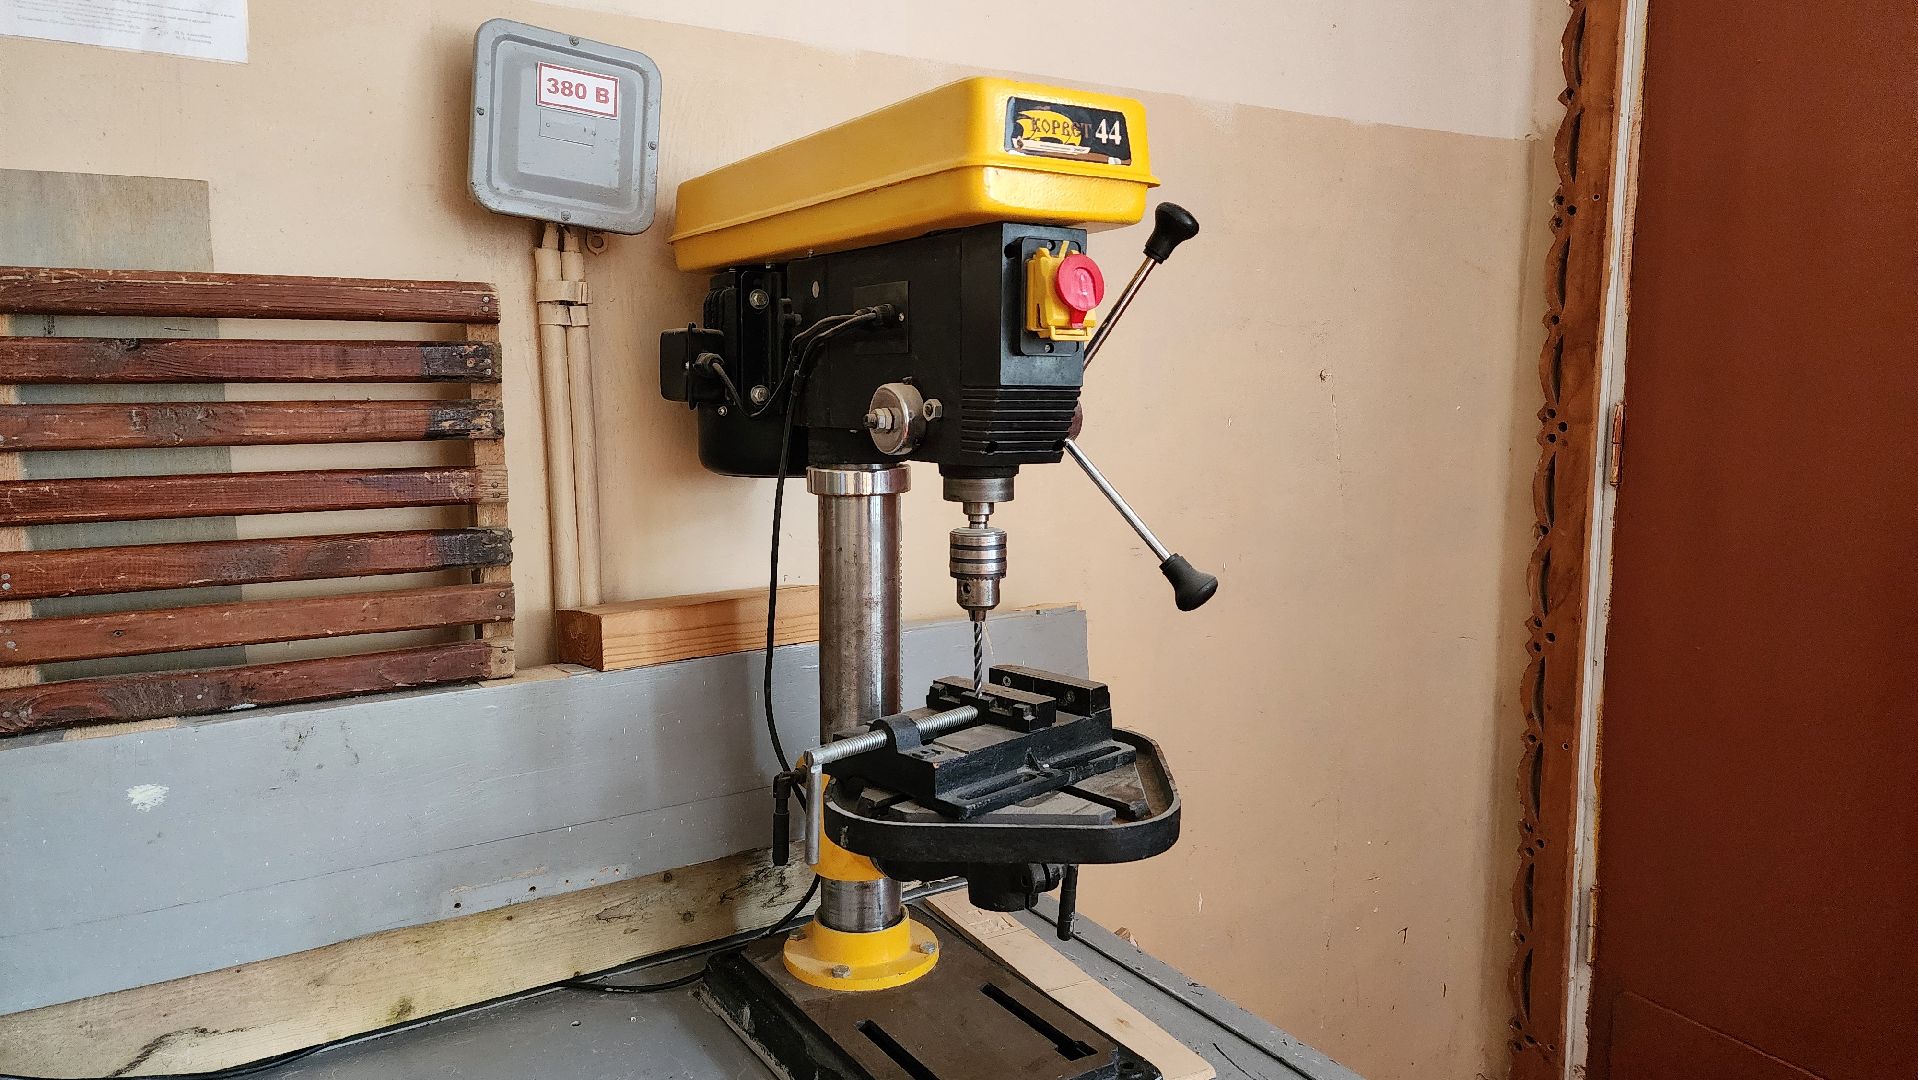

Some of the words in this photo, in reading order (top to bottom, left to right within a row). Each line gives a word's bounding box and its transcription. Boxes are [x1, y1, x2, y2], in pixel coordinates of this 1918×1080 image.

[547, 77, 587, 99] 380
[595, 87, 610, 104] В
[1032, 117, 1092, 139] КОРВЕТ
[1096, 118, 1122, 145] 44
